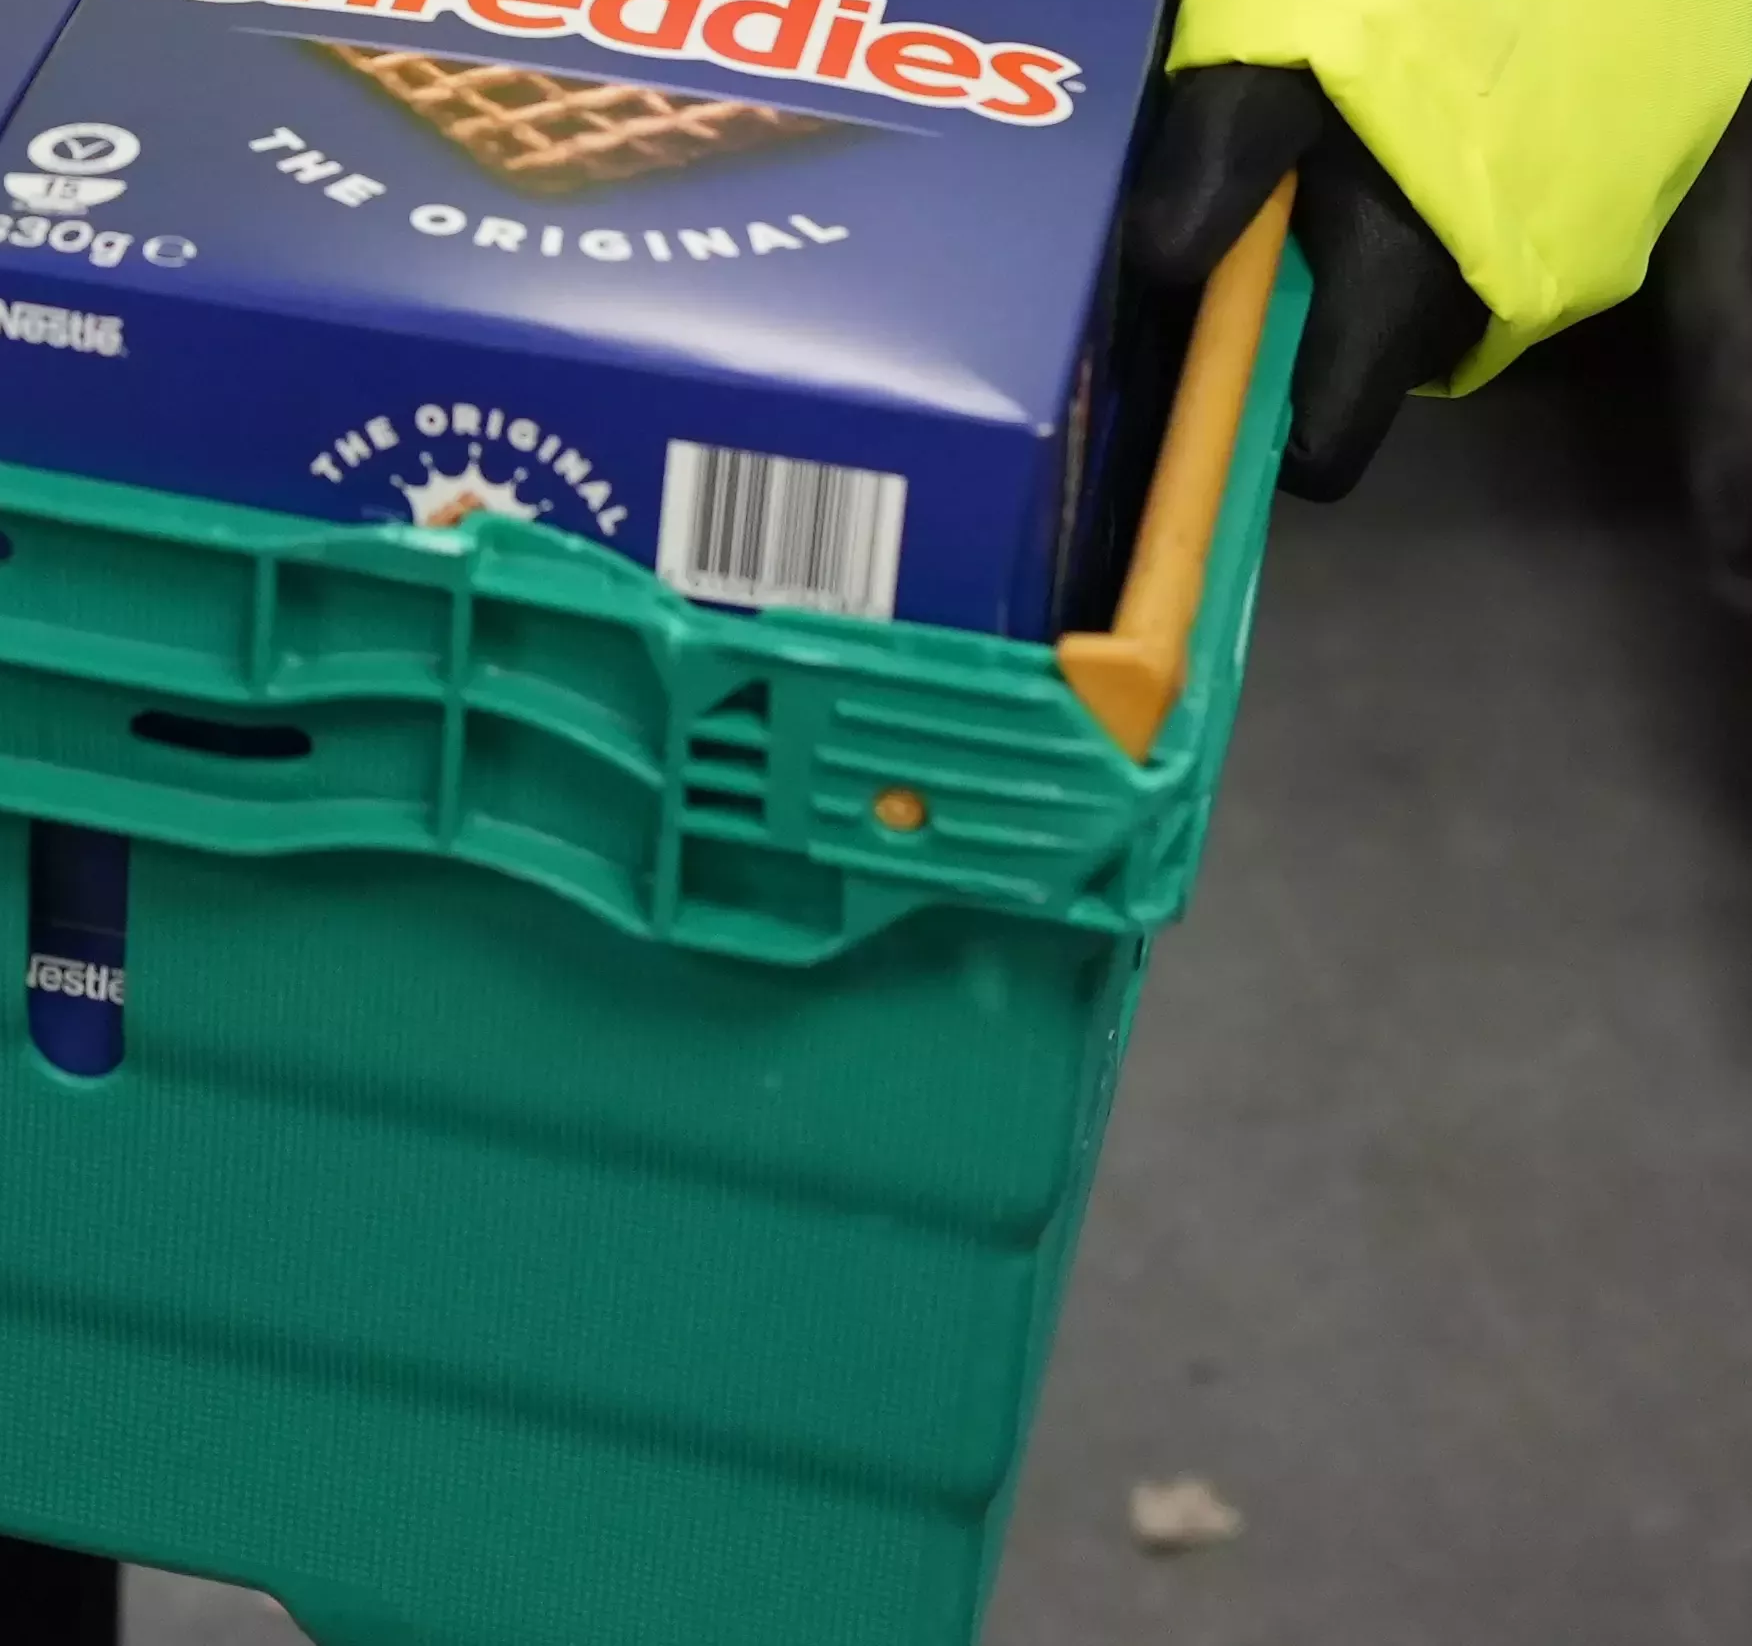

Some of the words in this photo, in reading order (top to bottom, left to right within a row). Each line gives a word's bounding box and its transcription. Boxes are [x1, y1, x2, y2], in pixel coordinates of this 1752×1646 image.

[248, 126, 386, 207] THE
[409, 203, 851, 262] ORIGINAL
[310, 416, 399, 485] THE
[413, 403, 630, 537] ORIGINAL
[27, 953, 124, 1006] estlé
